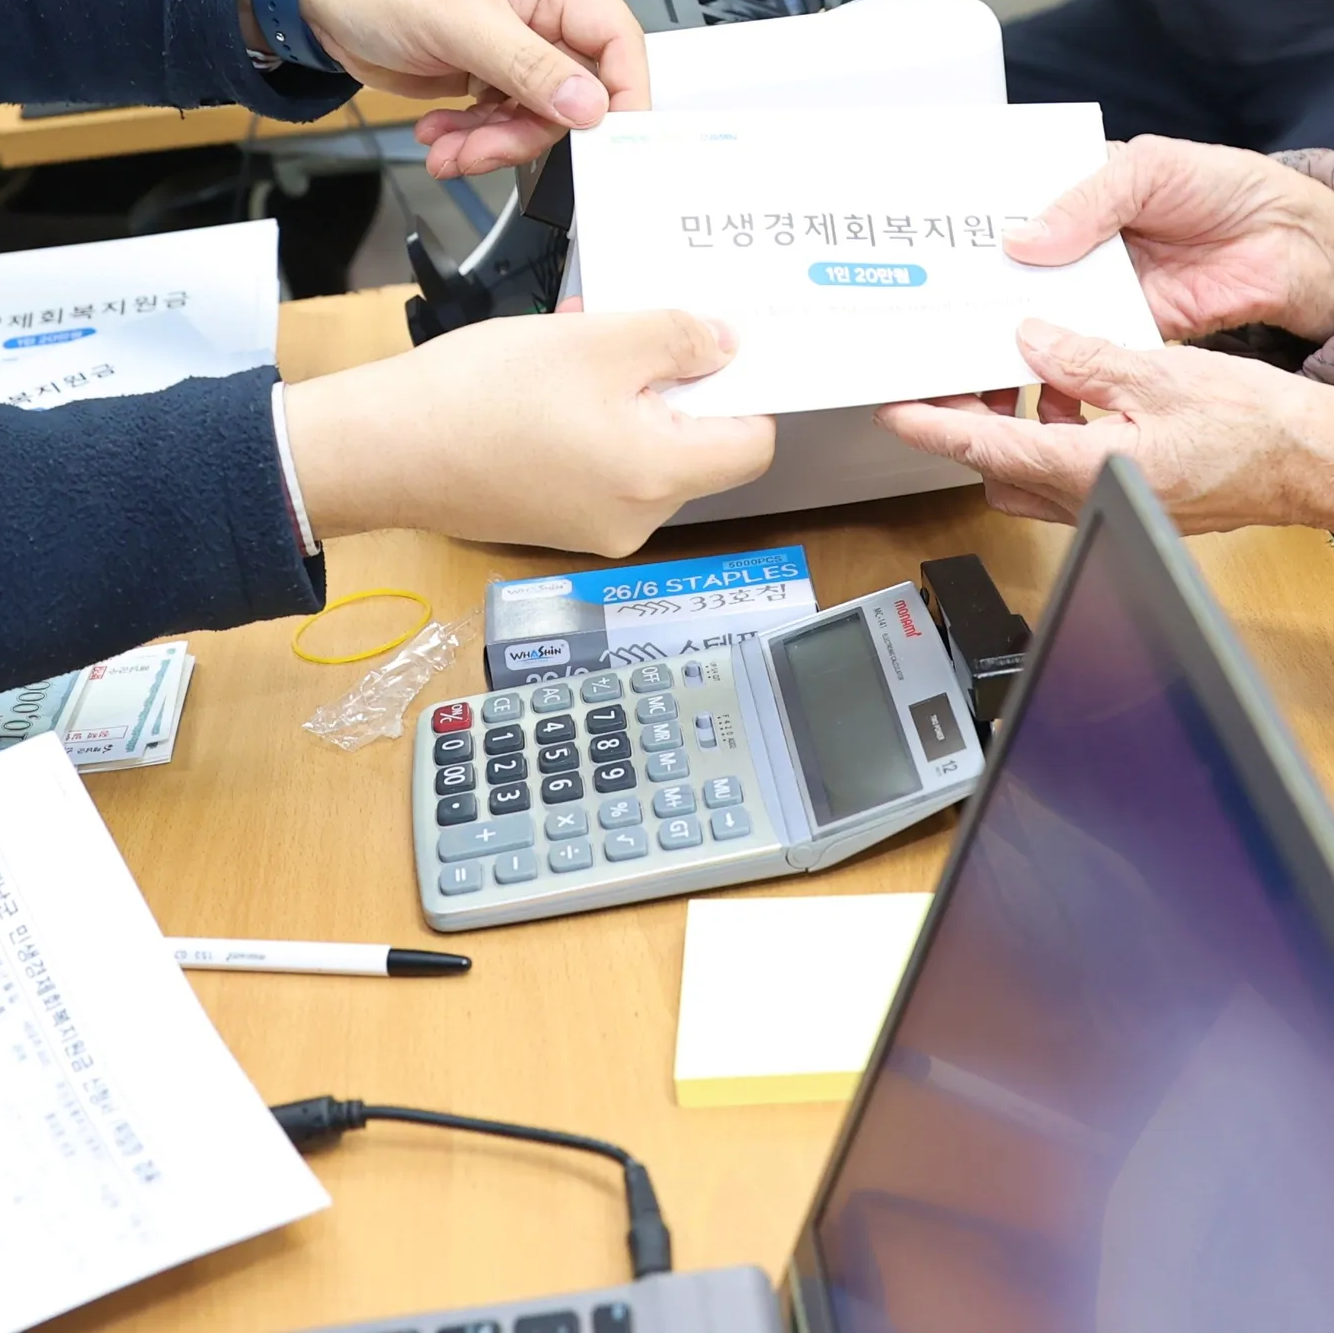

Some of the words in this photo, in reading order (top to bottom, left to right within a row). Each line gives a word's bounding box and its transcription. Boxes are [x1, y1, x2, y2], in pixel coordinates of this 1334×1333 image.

[728, 555, 782, 568] 5000PCS
[603, 582, 658, 602] 26/6
[666, 564, 799, 593] STAPLES
[873, 608, 887, 629] MC-141
[641, 666, 660, 686] OFF
[542, 688, 561, 703] AC
[493, 698, 511, 713] CE
[648, 696, 665, 714] MC
[593, 710, 615, 721] 7
[542, 722, 565, 733] 4
[652, 724, 669, 743] MR
[492, 733, 514, 742] 1
[597, 739, 619, 750] 8
[442, 740, 464, 751] 0
[545, 748, 567, 761] 5
[494, 761, 516, 772] 2
[942, 759, 958, 773] 12
[444, 768, 465, 784] 00
[601, 768, 625, 780] 9
[549, 779, 571, 791] 6
[713, 778, 730, 798] MU
[497, 789, 520, 801] 3
[669, 821, 689, 838] GT
[9, 924, 94, 1074] 민생경제회복지원금
